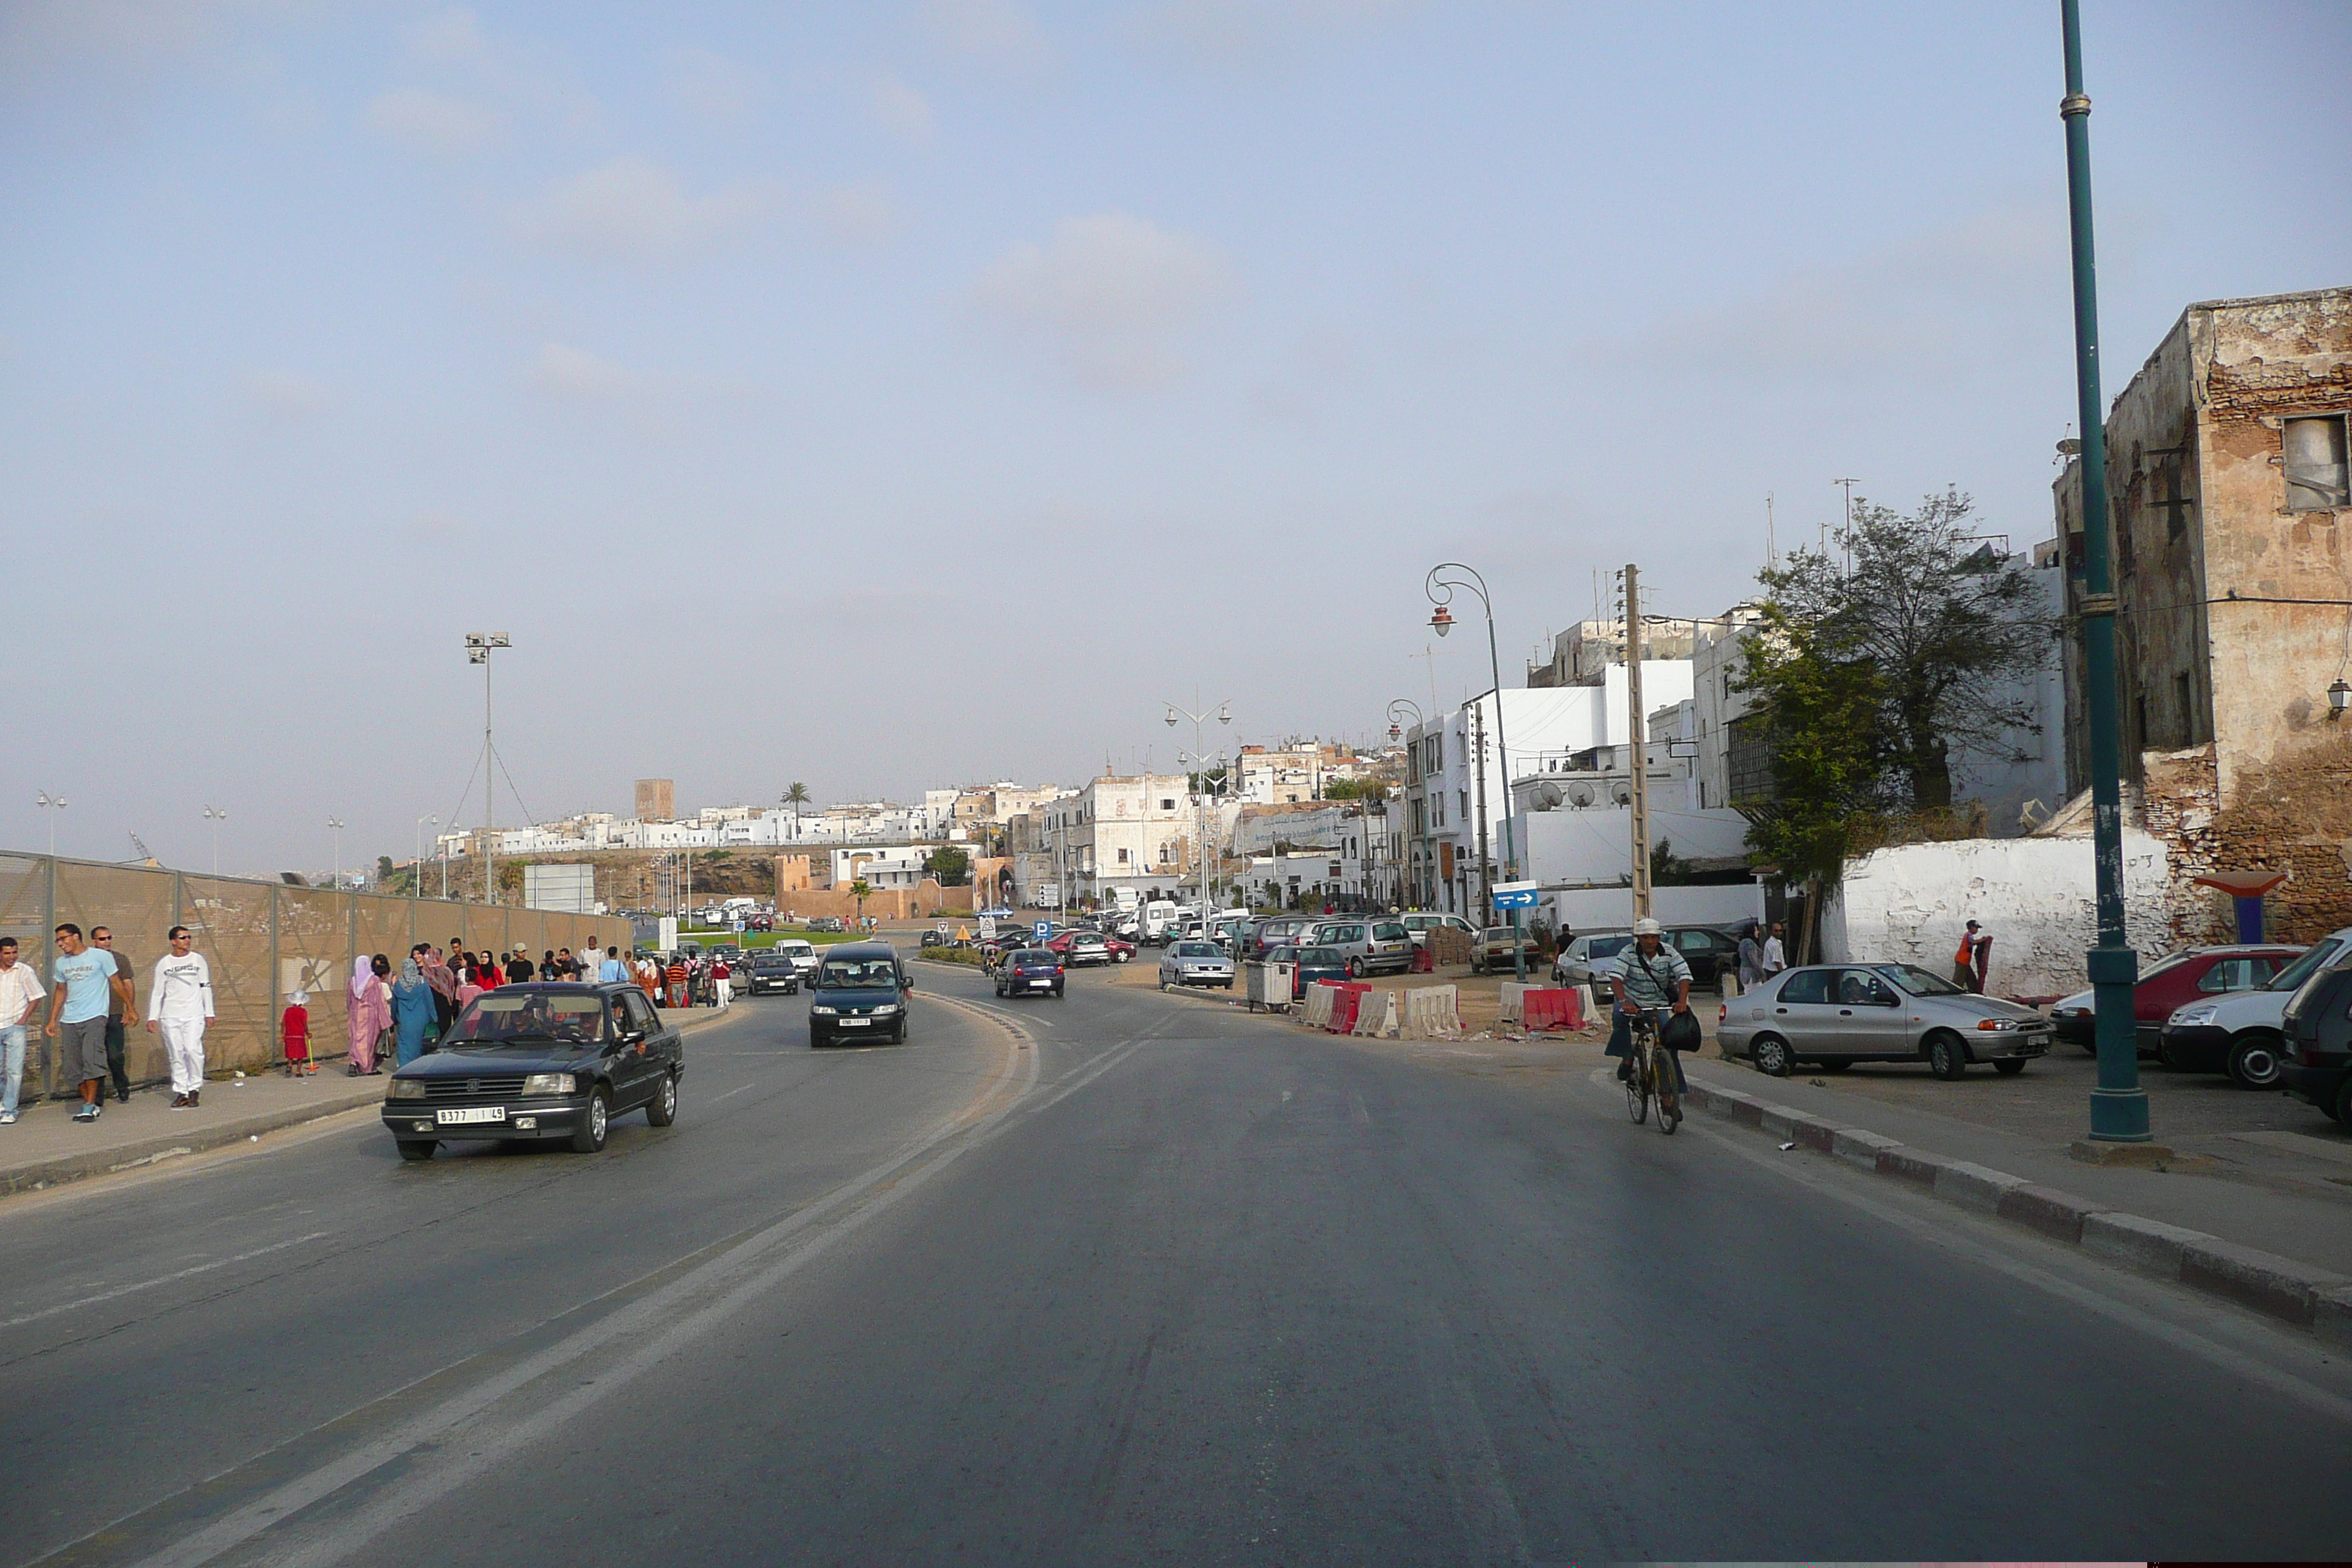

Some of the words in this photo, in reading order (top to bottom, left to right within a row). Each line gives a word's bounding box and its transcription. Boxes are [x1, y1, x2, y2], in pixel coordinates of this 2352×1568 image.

[1037, 923, 1048, 936] P
[441, 1111, 466, 1121] 8377
[491, 1108, 502, 1119] 49
